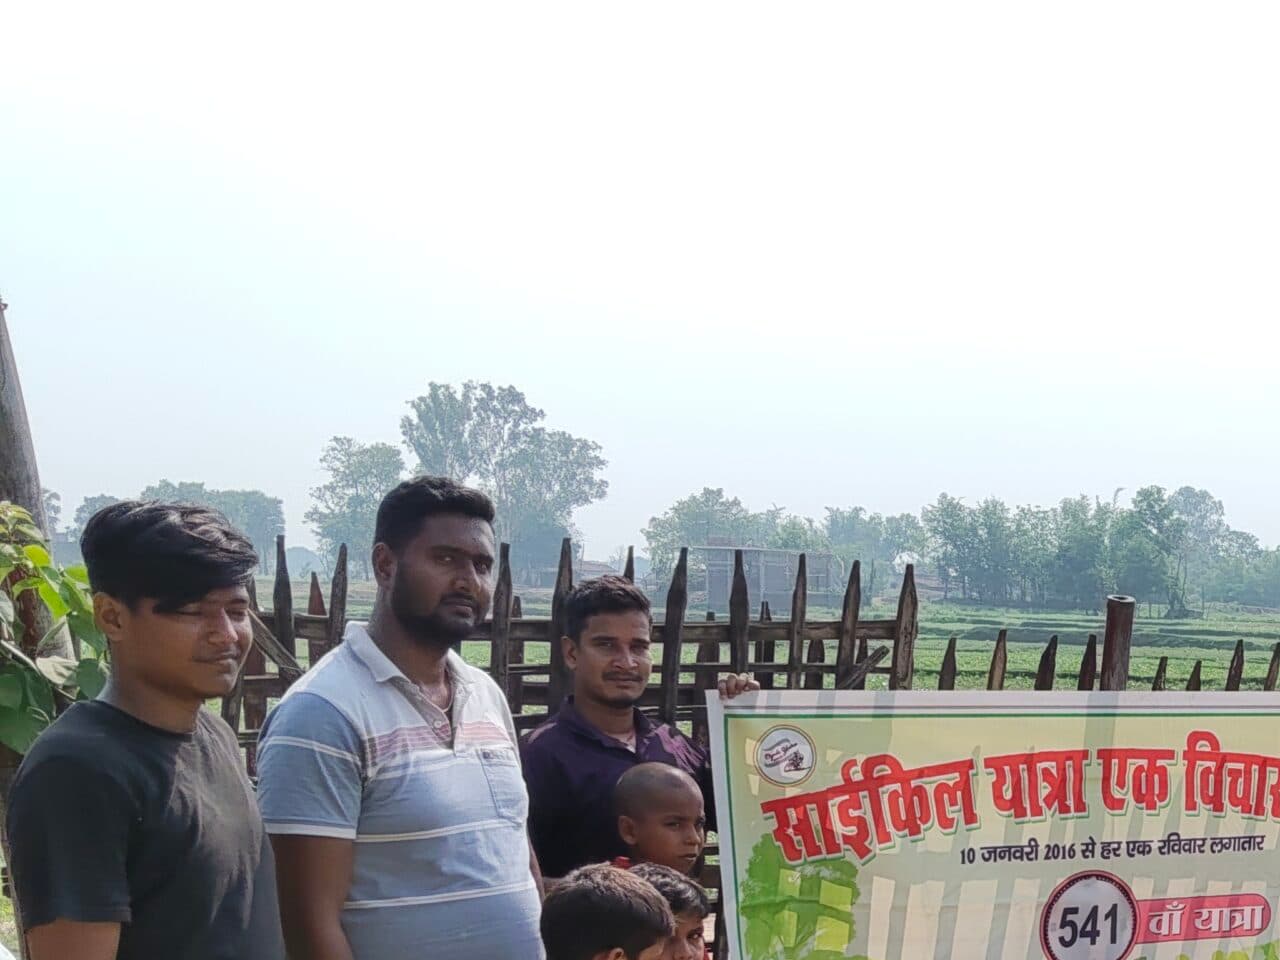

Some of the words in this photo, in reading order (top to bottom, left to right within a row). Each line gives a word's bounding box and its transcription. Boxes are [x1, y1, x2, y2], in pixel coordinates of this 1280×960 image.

[760, 753, 981, 864] साईकिल
[983, 748, 1090, 821] यात्रा
[1096, 747, 1176, 813] एक
[960, 847, 976, 865] 10
[980, 837, 1039, 863] जनवरी
[1043, 841, 1076, 861] 2016
[1080, 836, 1097, 859] से
[1100, 841, 1121, 860] हर
[1125, 840, 1152, 858] एक
[1157, 832, 1206, 856] रविवार
[1209, 835, 1266, 854] लगातार
[1057, 903, 1119, 948] 541
[1194, 905, 1266, 933] यात्रा
